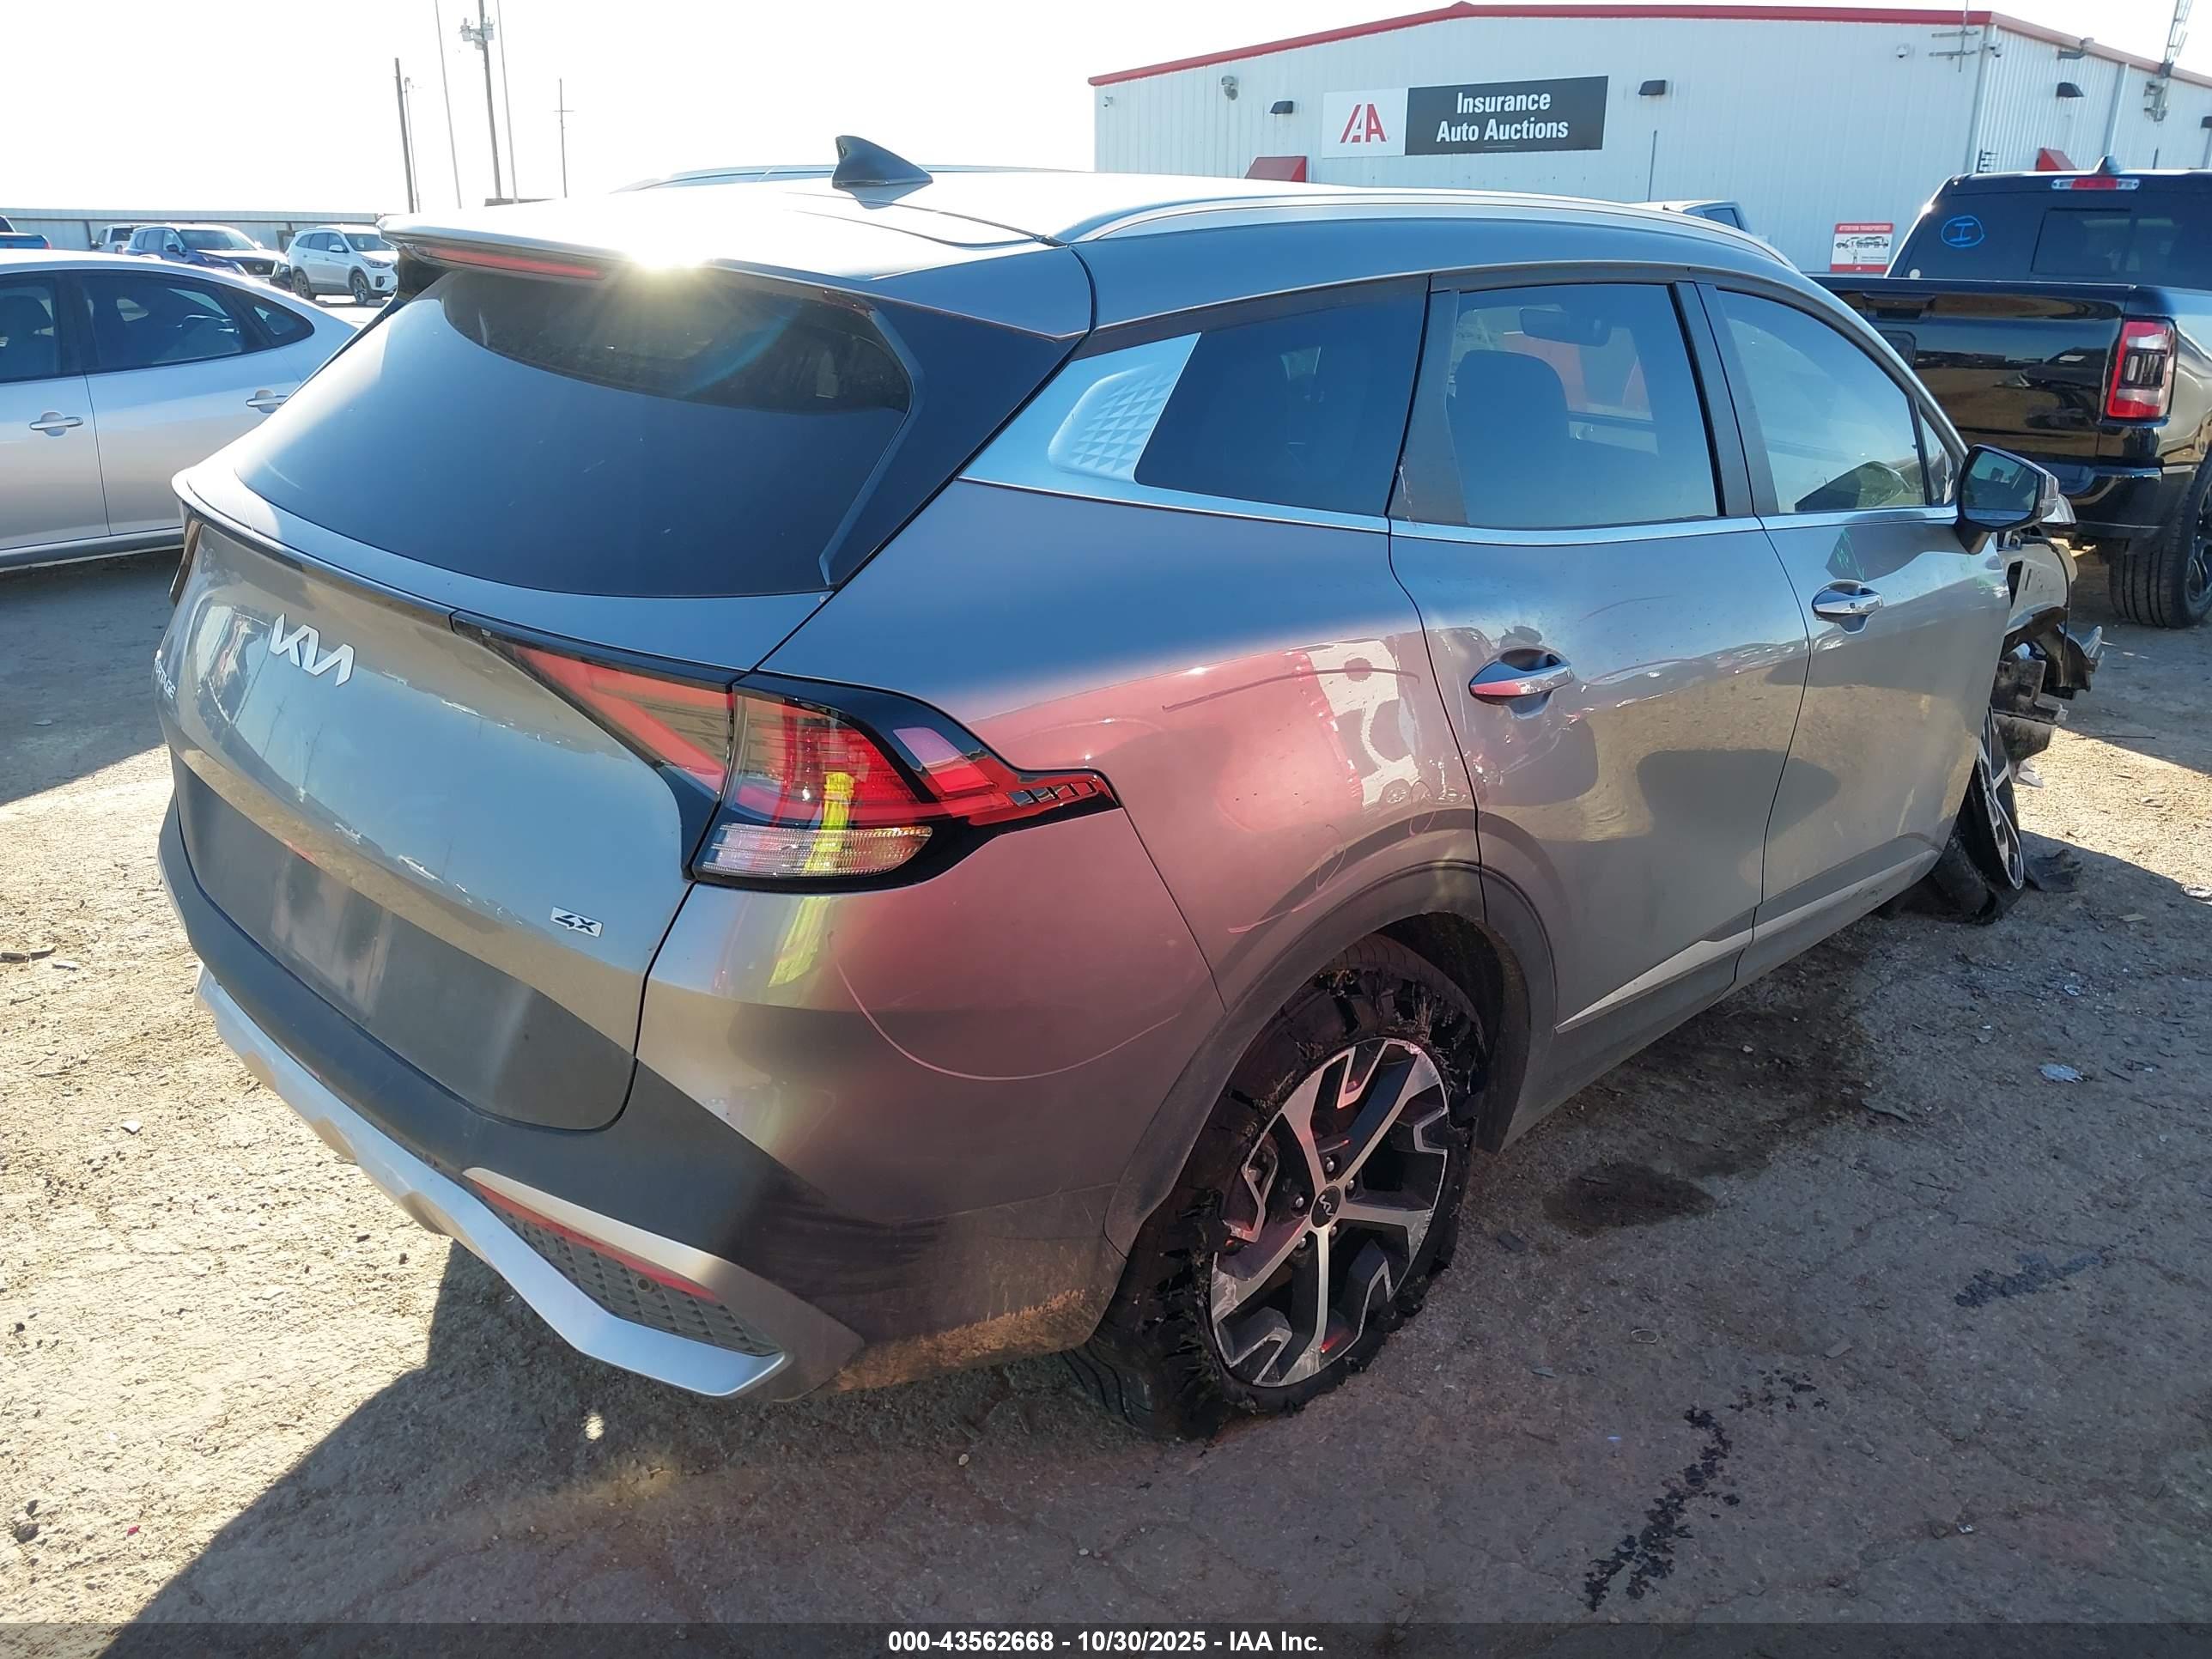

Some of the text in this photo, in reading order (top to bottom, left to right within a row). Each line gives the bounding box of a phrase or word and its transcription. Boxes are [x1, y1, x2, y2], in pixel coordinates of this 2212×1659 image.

[1456, 91, 1552, 113] Insurance
[1436, 117, 1570, 143] Auto Auctions
[269, 612, 355, 688] KIA
